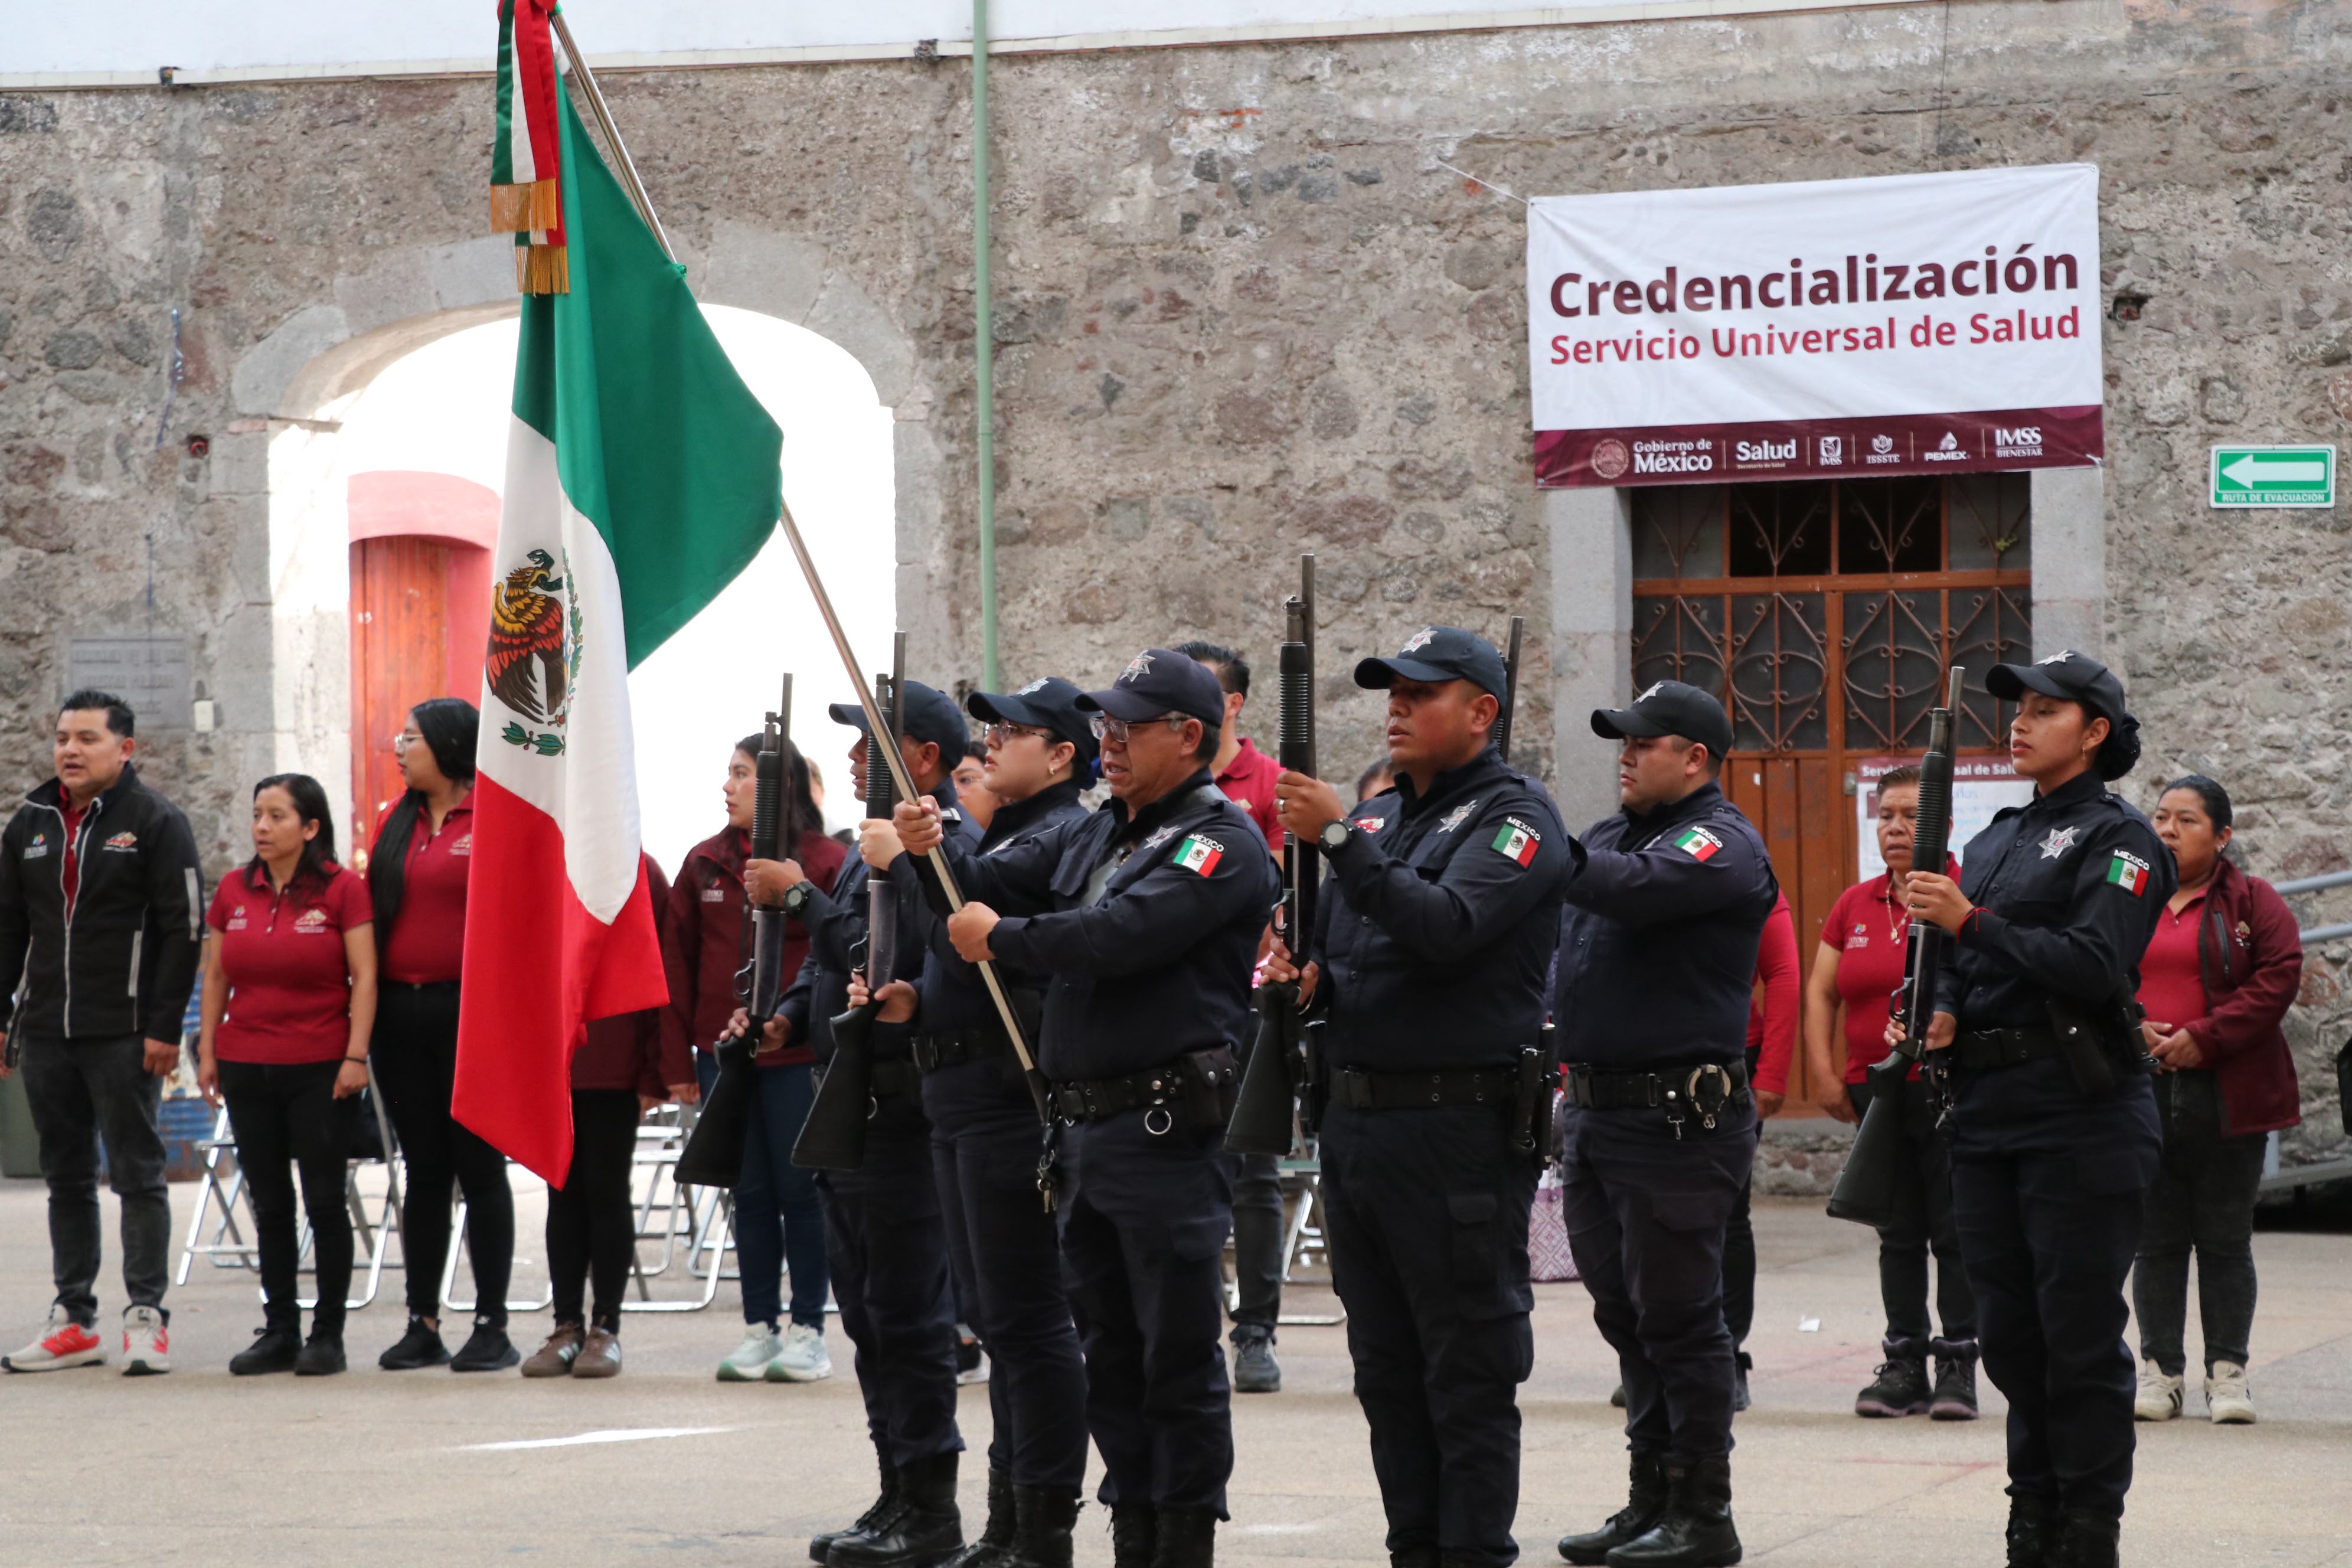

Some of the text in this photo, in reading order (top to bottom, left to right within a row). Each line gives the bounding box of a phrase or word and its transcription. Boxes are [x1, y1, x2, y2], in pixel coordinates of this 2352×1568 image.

[1551, 243, 2078, 318] Credencialización
[1551, 306, 2079, 365] Servicio Universal de Salud
[1633, 437, 1712, 453] Gobierno de
[1995, 427, 2043, 447] IMSS
[1735, 438, 1796, 462] Salud
[1923, 450, 1966, 462] PEMEX
[1996, 447, 2043, 458] BIENESTAR
[1634, 450, 1713, 473] México
[1819, 456, 1842, 466] IMSS
[1866, 454, 1900, 464] ISSSTE
[2222, 494, 2248, 502] RUTA
[2249, 494, 2262, 502] DE
[1974, 763, 1990, 775] de
[1188, 834, 1224, 852] MÉXICO
